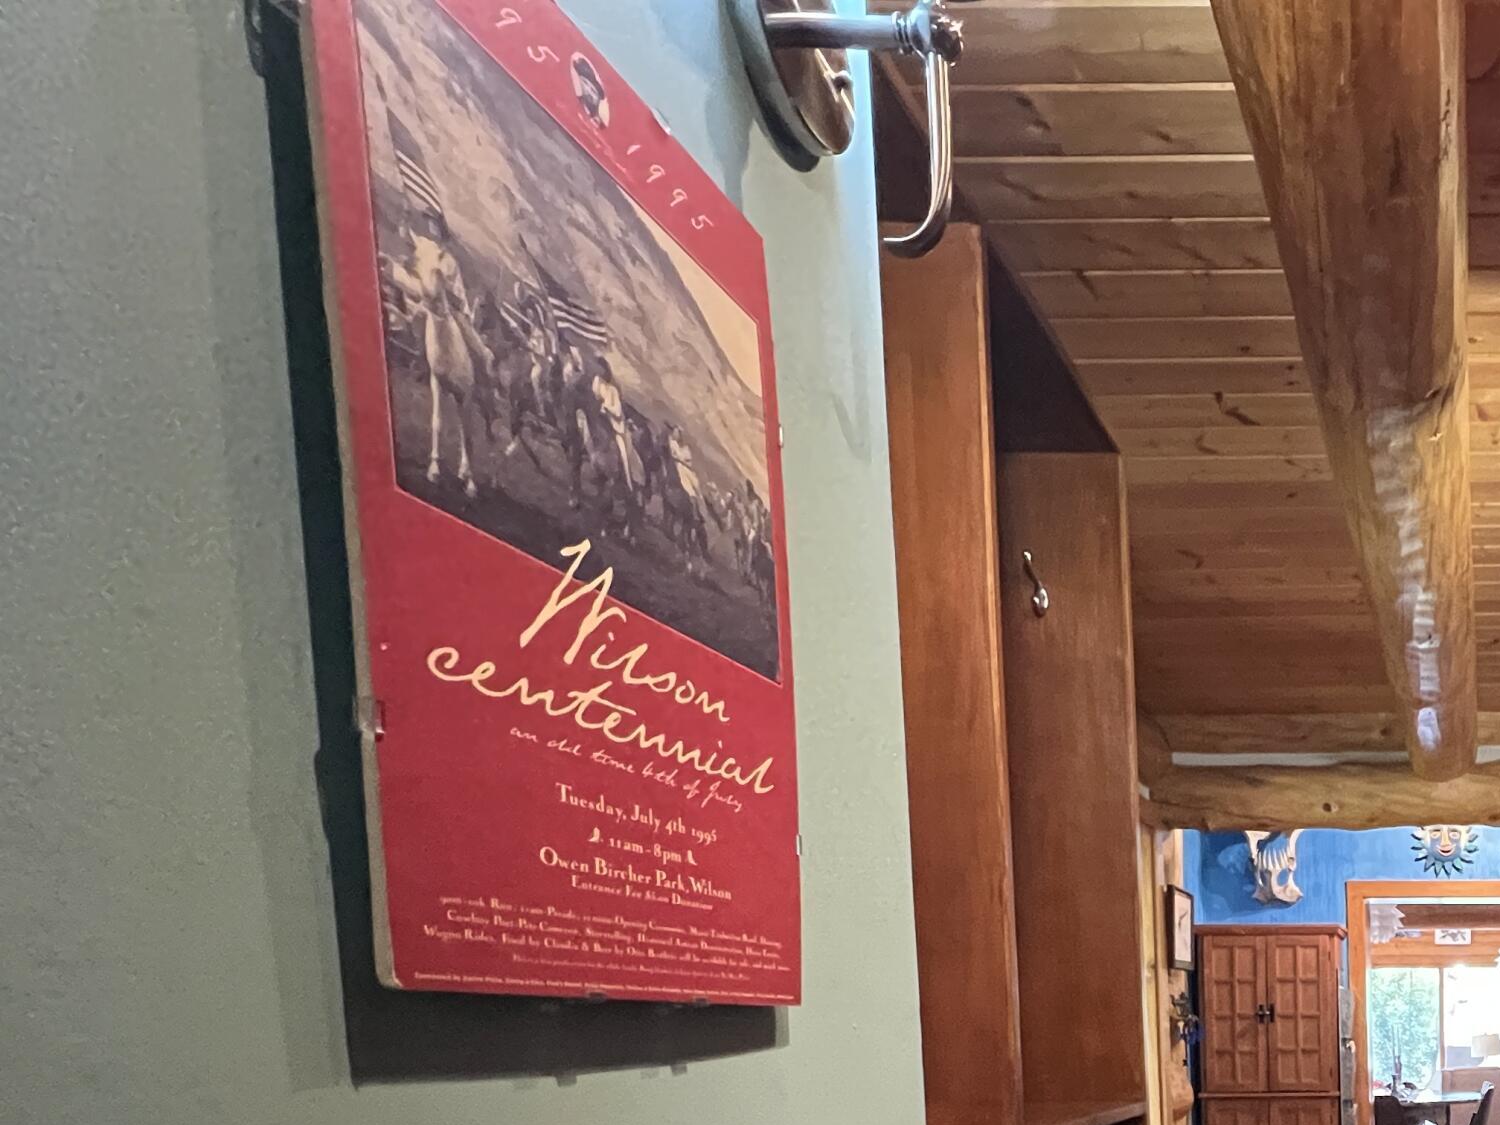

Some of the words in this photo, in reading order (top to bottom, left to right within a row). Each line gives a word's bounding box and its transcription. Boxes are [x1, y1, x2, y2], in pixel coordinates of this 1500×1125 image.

[626, 144, 714, 230] 1995
[518, 538, 731, 723] Wilson
[426, 646, 775, 795] centennial
[509, 726, 539, 744] an
[547, 737, 582, 757] old
[589, 748, 635, 774] time
[640, 761, 678, 788] 4th
[682, 779, 701, 799] of
[700, 782, 743, 813] July
[555, 781, 628, 824] Tuesday,
[630, 804, 661, 833] July
[664, 816, 687, 836] 4th
[691, 827, 718, 847] 1995
[539, 846, 590, 874] Owen
[594, 856, 652, 886] Bircher
[688, 876, 733, 901] Wilson
[570, 875, 622, 896] Entrance
